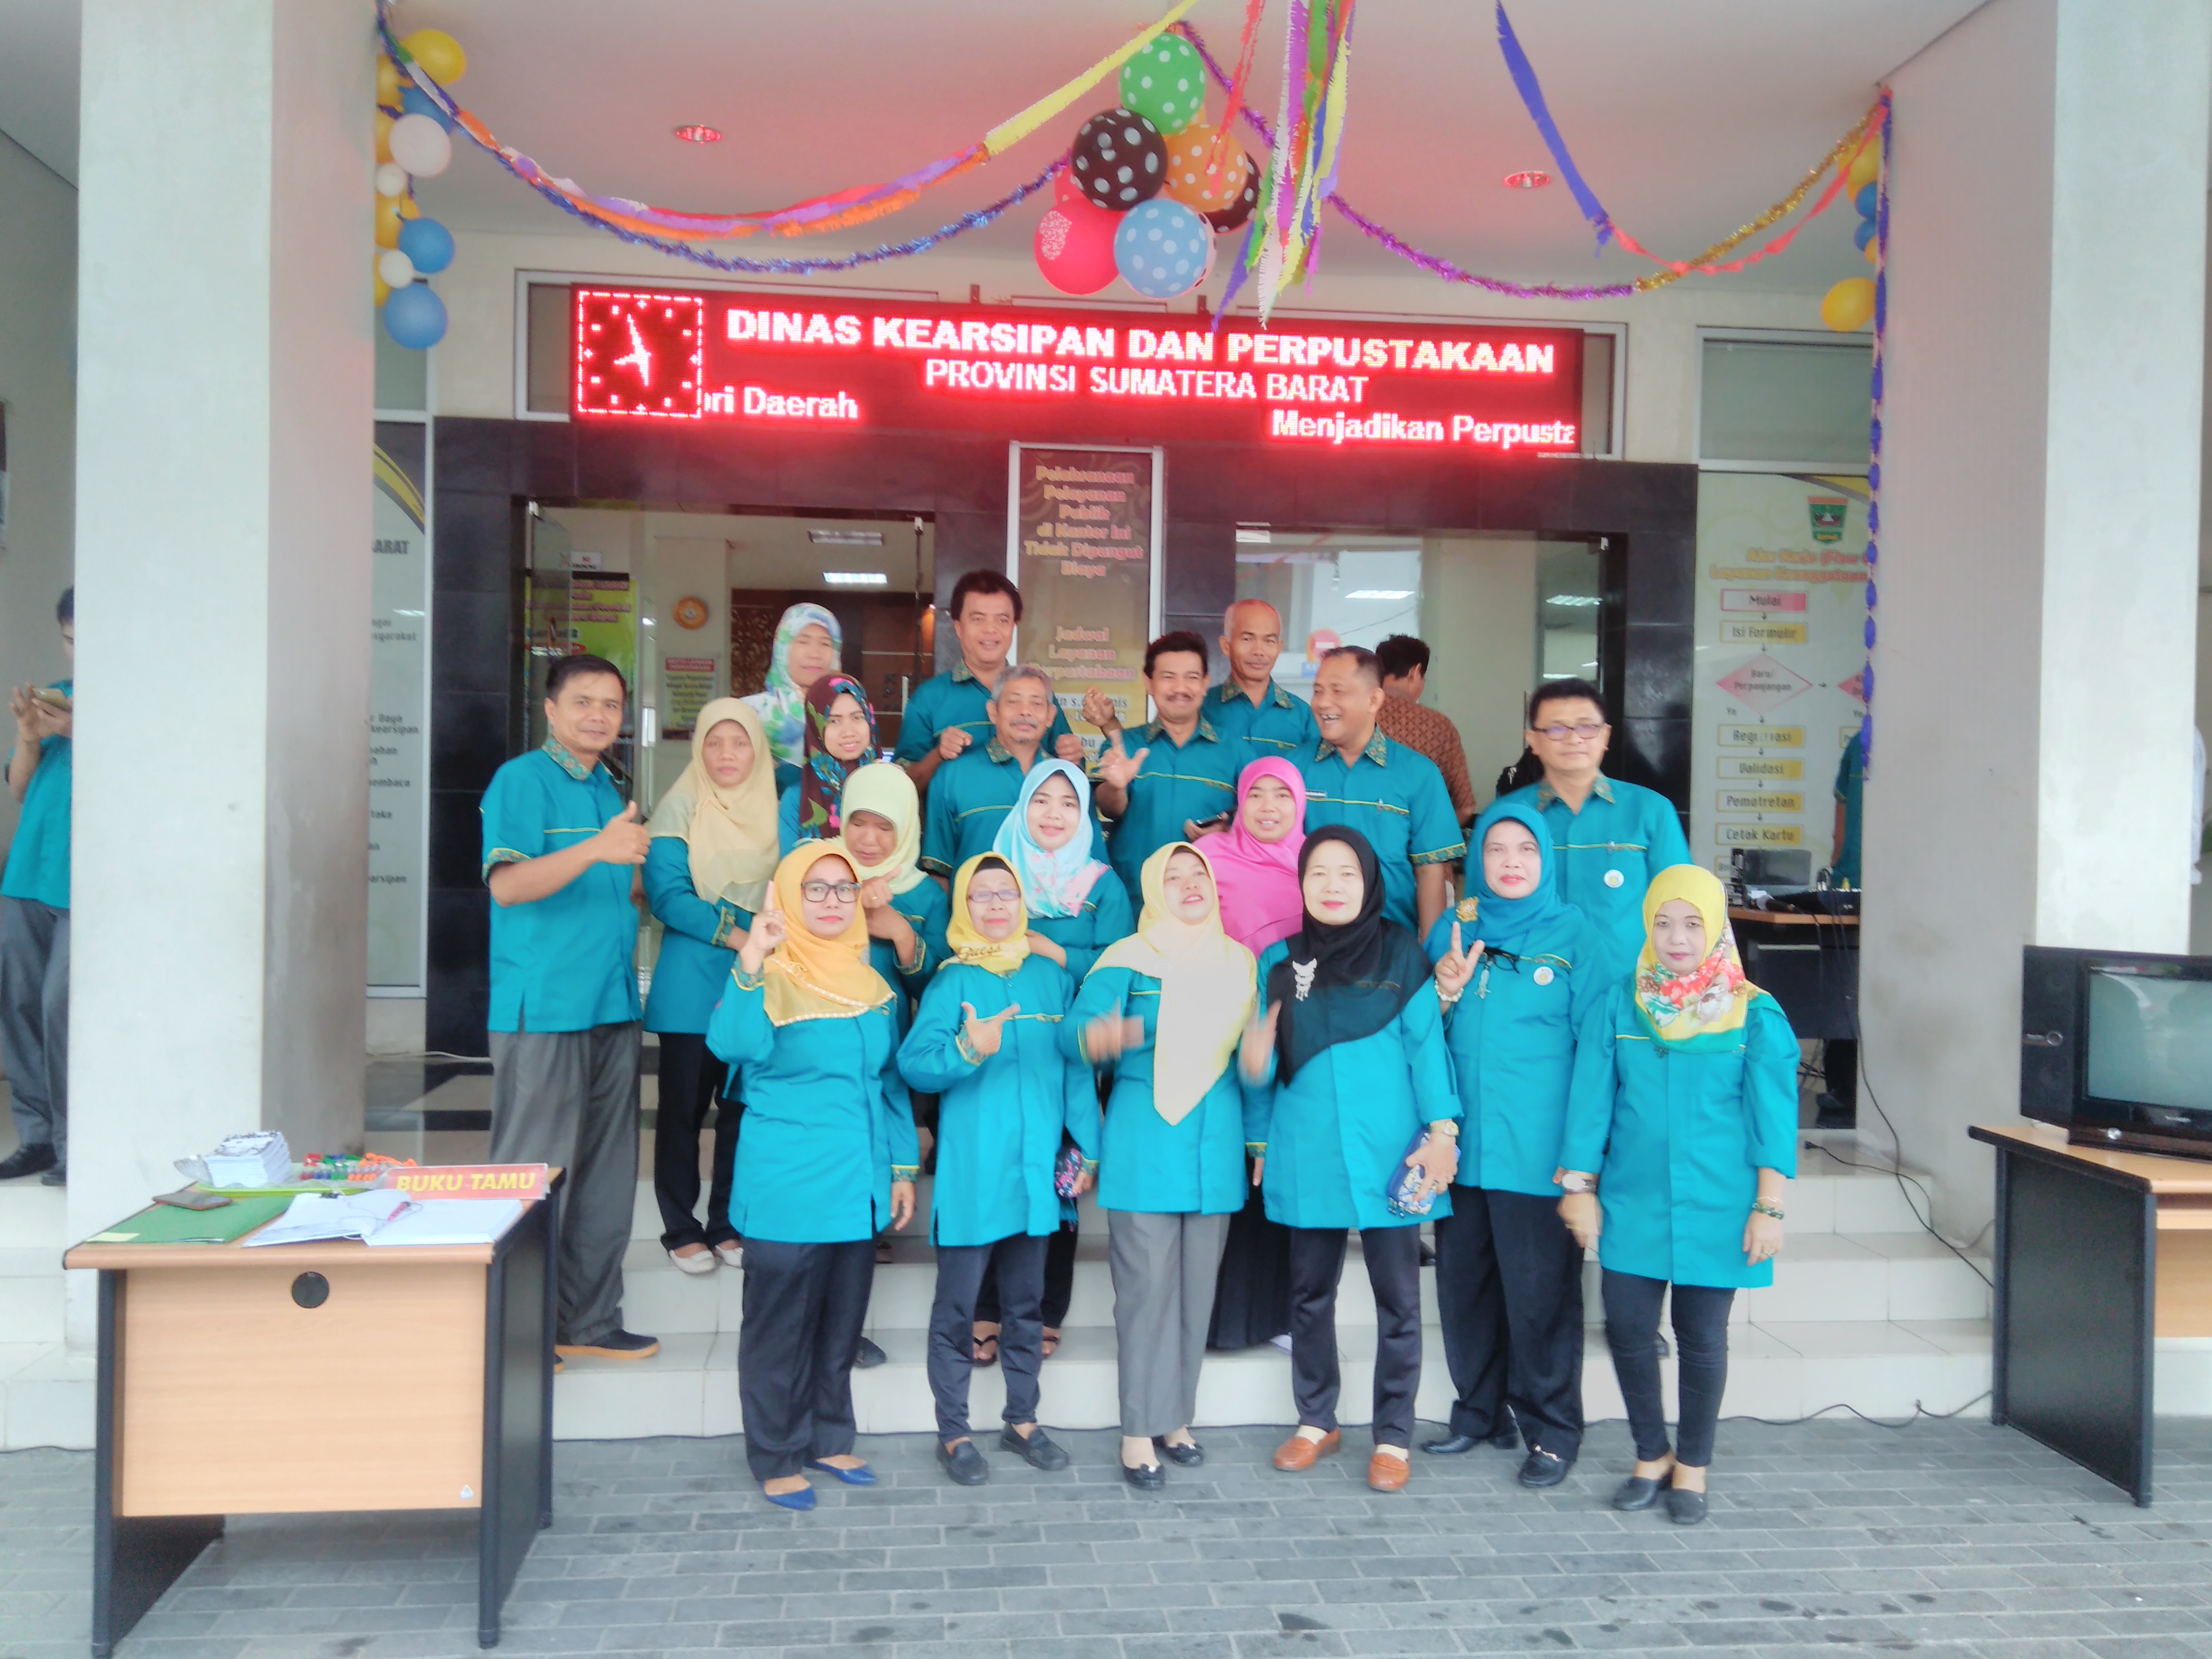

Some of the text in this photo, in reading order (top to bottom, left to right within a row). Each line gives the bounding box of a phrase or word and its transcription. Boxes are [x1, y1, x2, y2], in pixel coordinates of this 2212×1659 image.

[727, 308, 1554, 373] DINAS KEARSIPAN DAN PERPUSTAKAAN
[926, 358, 1370, 403] PROVINSI SUMATERA BARAT
[744, 387, 858, 418] Daerah
[1272, 409, 1445, 445] Menjadikan
[1044, 484, 1127, 504] Pelayanan
[1059, 504, 1111, 521] Publik
[1024, 540, 1143, 560] Tidak Dipungut
[1061, 560, 1107, 579] Biaya
[1749, 594, 1781, 607] Mulai
[1739, 762, 1784, 775] Validasi
[1727, 795, 1796, 808] Pemotretan
[1726, 828, 1795, 842] Cetak Kartu
[396, 1172, 535, 1192] BUKU TAMU
